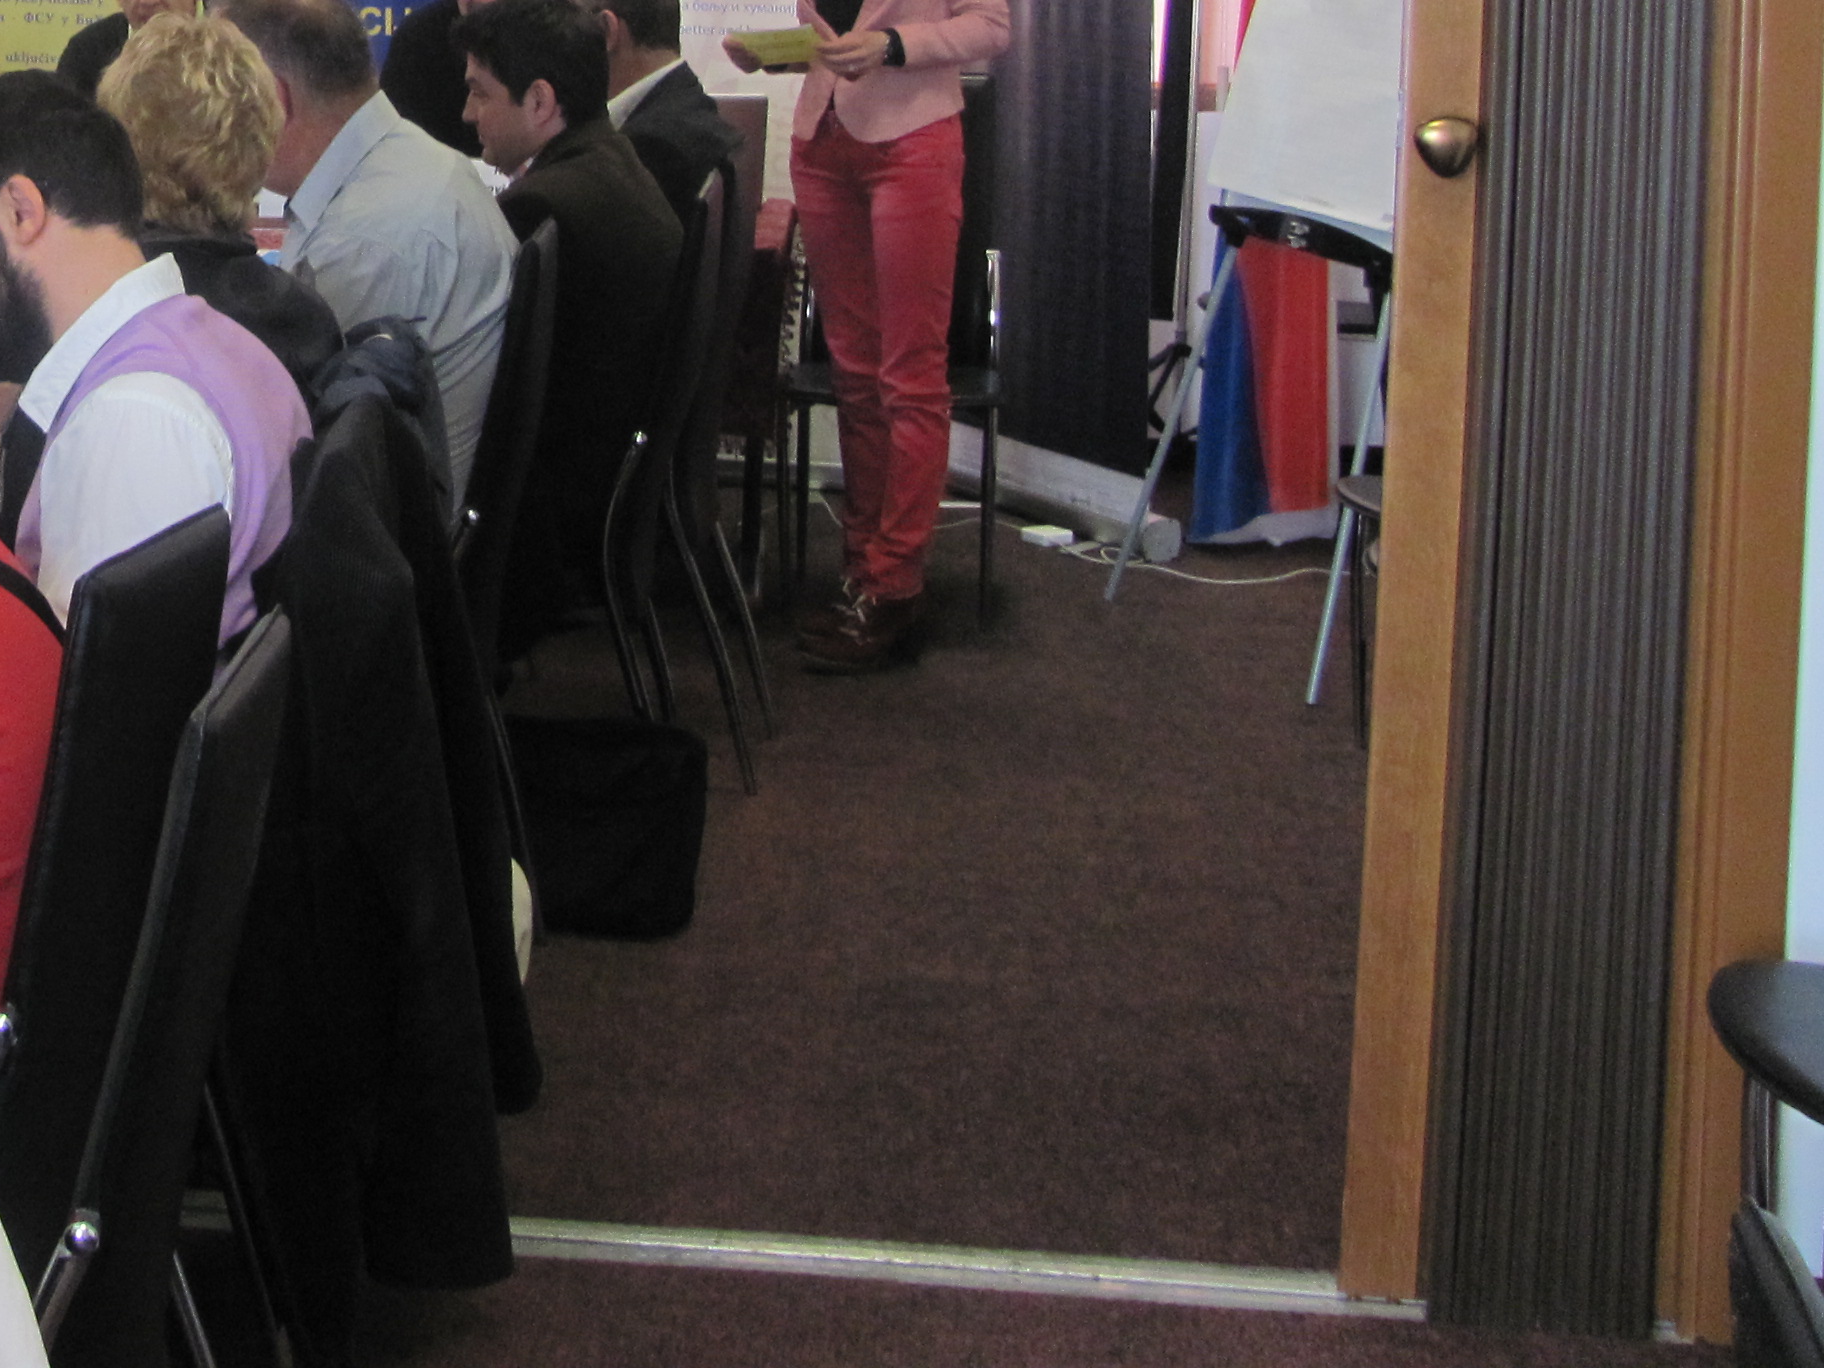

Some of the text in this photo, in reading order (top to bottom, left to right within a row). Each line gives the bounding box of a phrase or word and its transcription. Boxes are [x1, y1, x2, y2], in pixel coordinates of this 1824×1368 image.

[745, 3, 797, 17] хуманиј
[24, 11, 55, 25] ФСУ
[5, 52, 60, 65] uključiv
